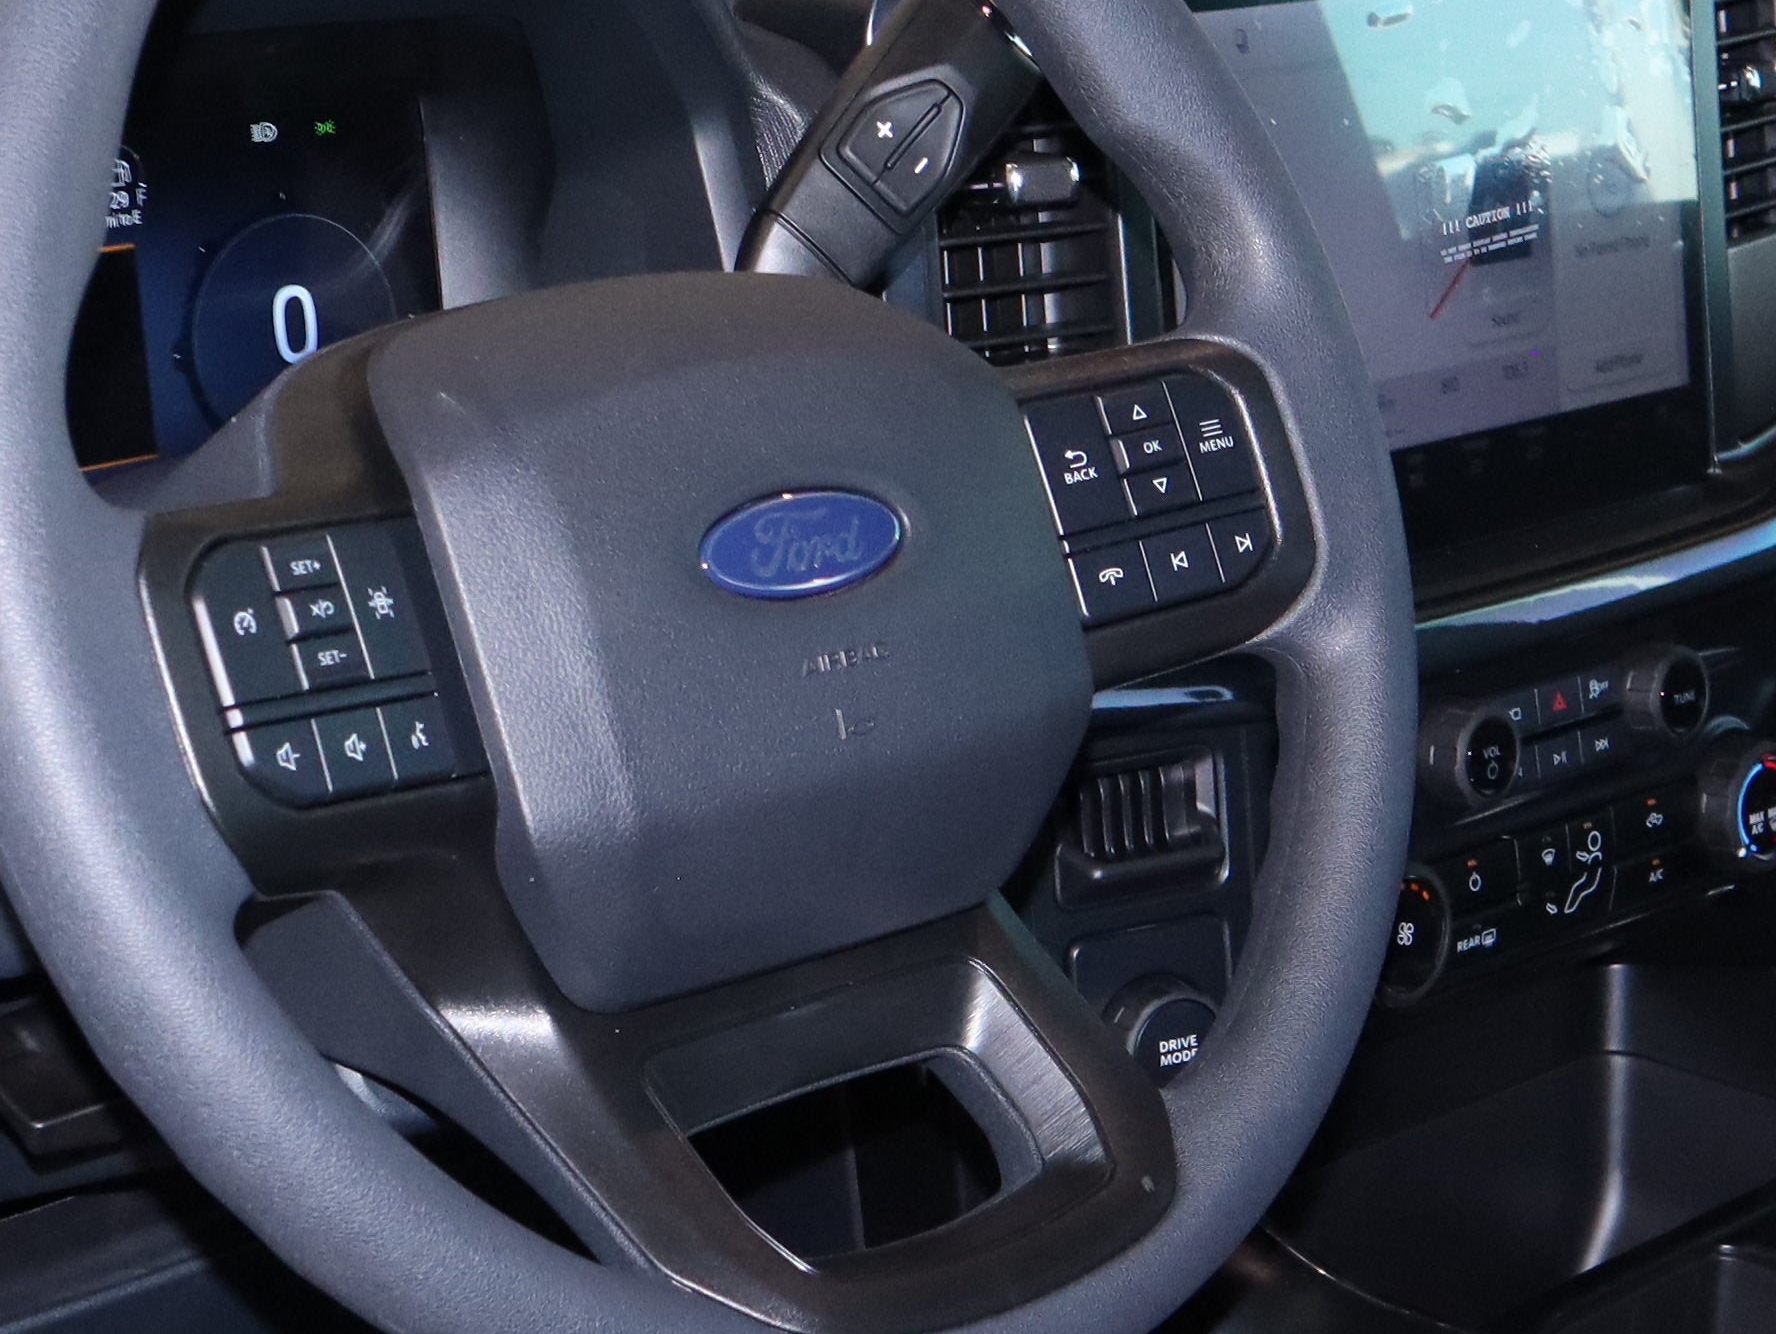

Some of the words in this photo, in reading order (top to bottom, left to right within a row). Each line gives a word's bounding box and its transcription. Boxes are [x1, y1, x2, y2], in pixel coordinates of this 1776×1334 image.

[1465, 206, 1511, 229] CAUTION
[273, 284, 319, 365] 0
[1143, 439, 1163, 454] OK
[1198, 436, 1235, 454] MENU
[1063, 466, 1099, 485] BACK
[751, 507, 863, 578] Ford
[1483, 746, 1501, 759] VOL
[1457, 935, 1481, 952] REAR
[1159, 1034, 1199, 1054] DRIVE
